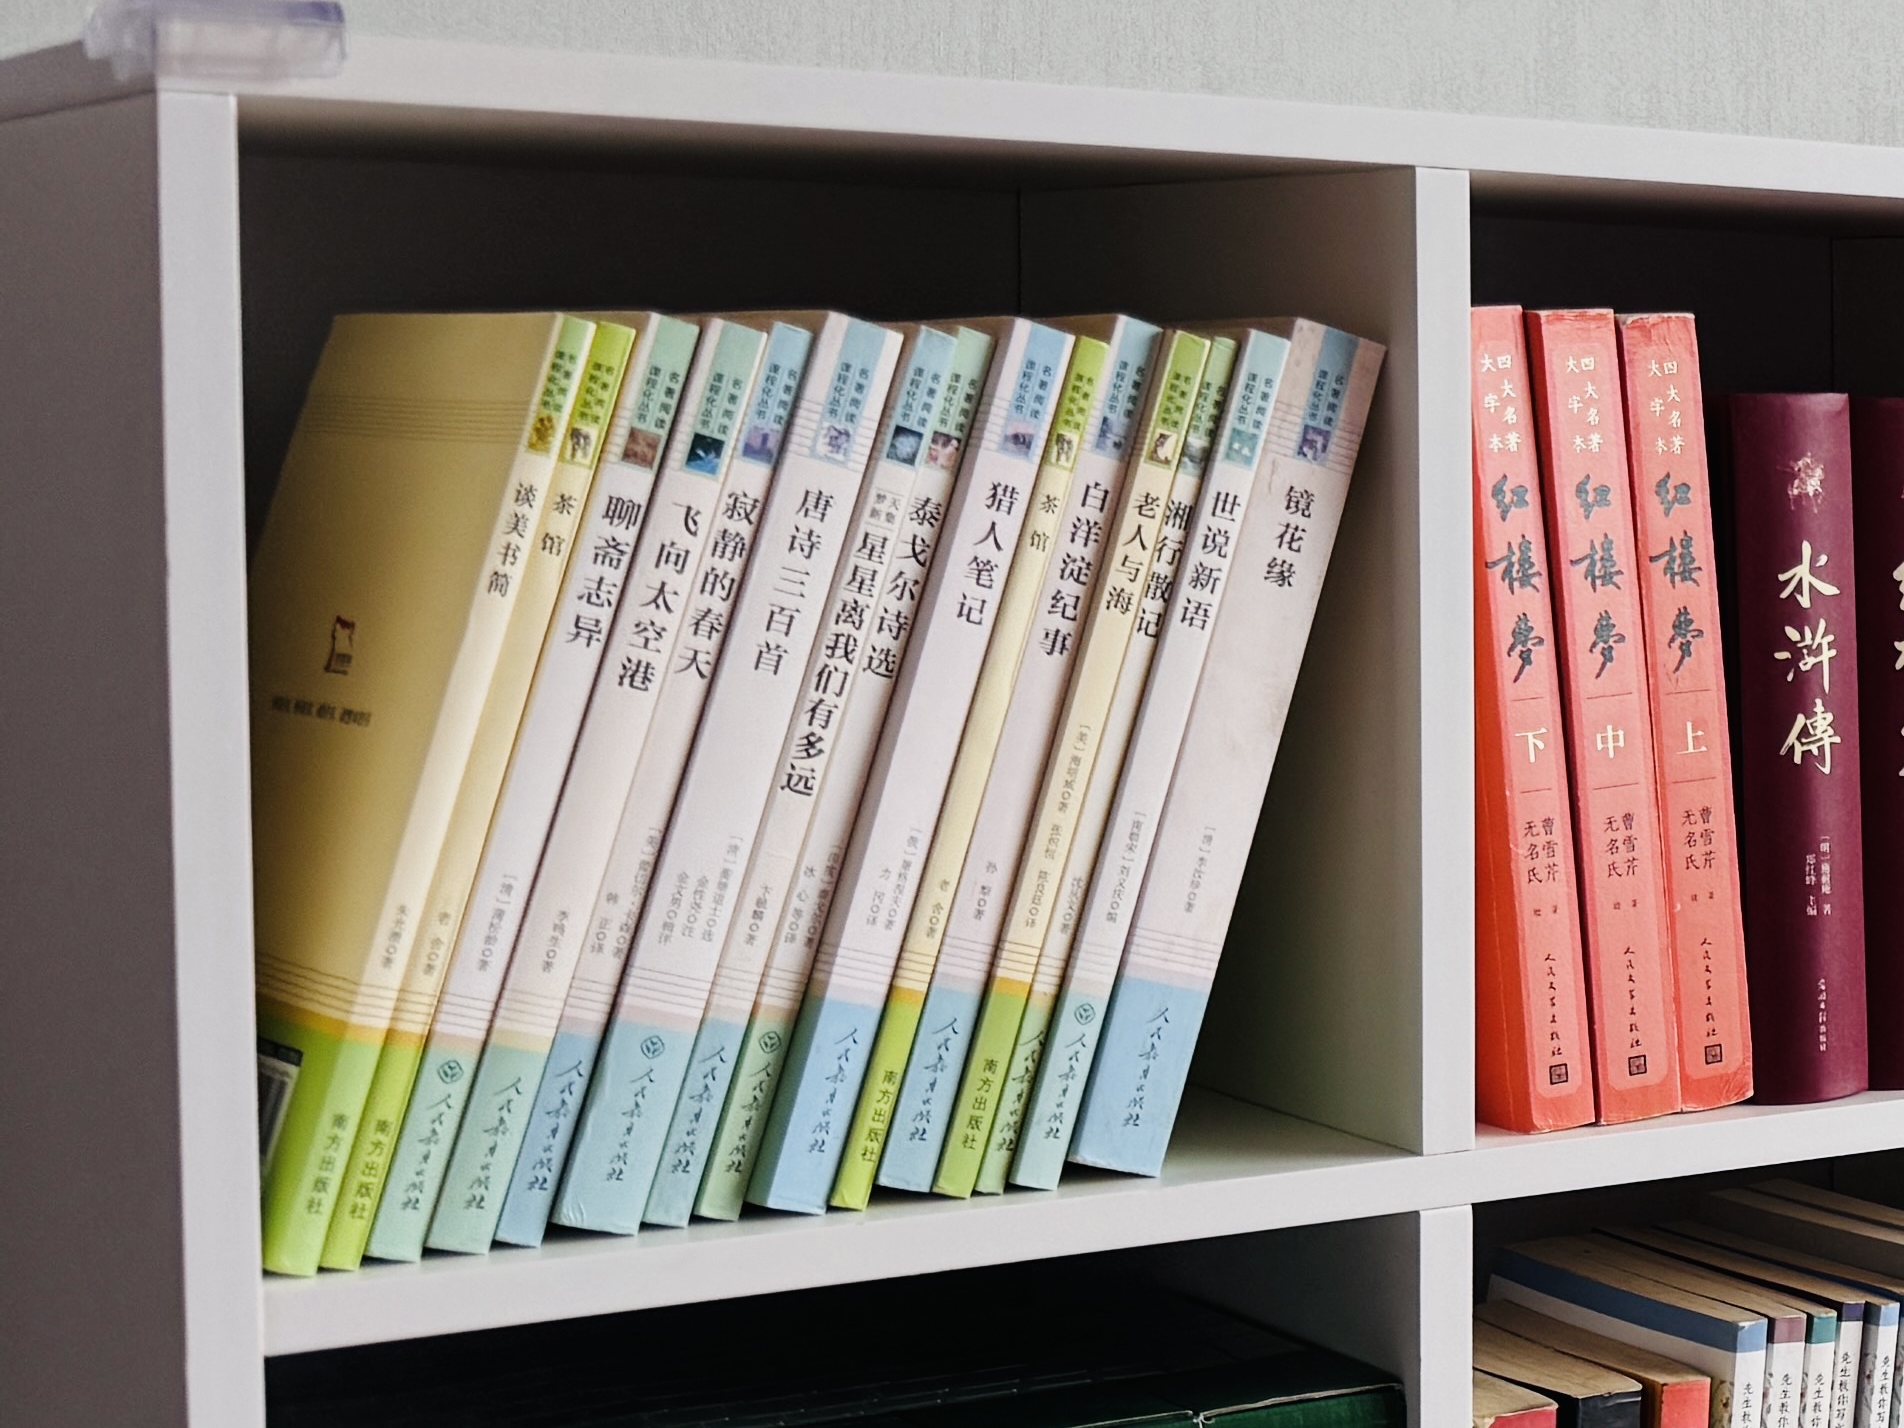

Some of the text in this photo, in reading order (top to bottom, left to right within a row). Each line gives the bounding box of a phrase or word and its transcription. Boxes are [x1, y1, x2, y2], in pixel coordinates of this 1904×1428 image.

[1480, 355, 1502, 453] 大字本
[1497, 355, 1523, 453] 四大名著
[1565, 356, 1589, 453] 大字本
[1581, 357, 1604, 453] 四大名著
[1647, 360, 1669, 456] 大字本
[1663, 361, 1686, 456] 四大名著
[486, 481, 538, 599] 谈美书简
[540, 491, 577, 560] 茶馆
[565, 493, 640, 650] 聊斋志异
[956, 480, 1020, 627] 猎人笔记
[1028, 493, 1061, 555] 茶馆
[1038, 481, 1110, 658] 白洋淀纪事
[1105, 492, 1162, 616] 老人与海
[1136, 499, 1194, 641] 湘行散记
[1180, 489, 1242, 631] 世说新语
[1263, 485, 1318, 589] 镜花缘
[617, 500, 701, 694] 飞向太空港
[678, 489, 761, 680] 寂静的春天
[753, 488, 836, 677] 唐诗三百首
[862, 495, 943, 681] 泰戈尔诗选
[780, 529, 888, 798] 星星离我们有多远
[1515, 727, 1548, 763] 下
[1596, 724, 1625, 759] 中
[1677, 721, 1708, 755] 上
[1523, 820, 1544, 885] 无名氏
[1540, 815, 1560, 883] 曹雪芹
[1604, 815, 1623, 879] 无名氏
[1622, 812, 1639, 877] 曹雪芹
[1681, 809, 1701, 871] 无名氏
[1699, 806, 1716, 870] 曹雪芹
[860, 1068, 899, 1162] 南方出版社
[962, 1058, 999, 1150] 南方出版社
[307, 1113, 346, 1215] 南方出版社
[350, 1119, 395, 1220] 南方出版社
